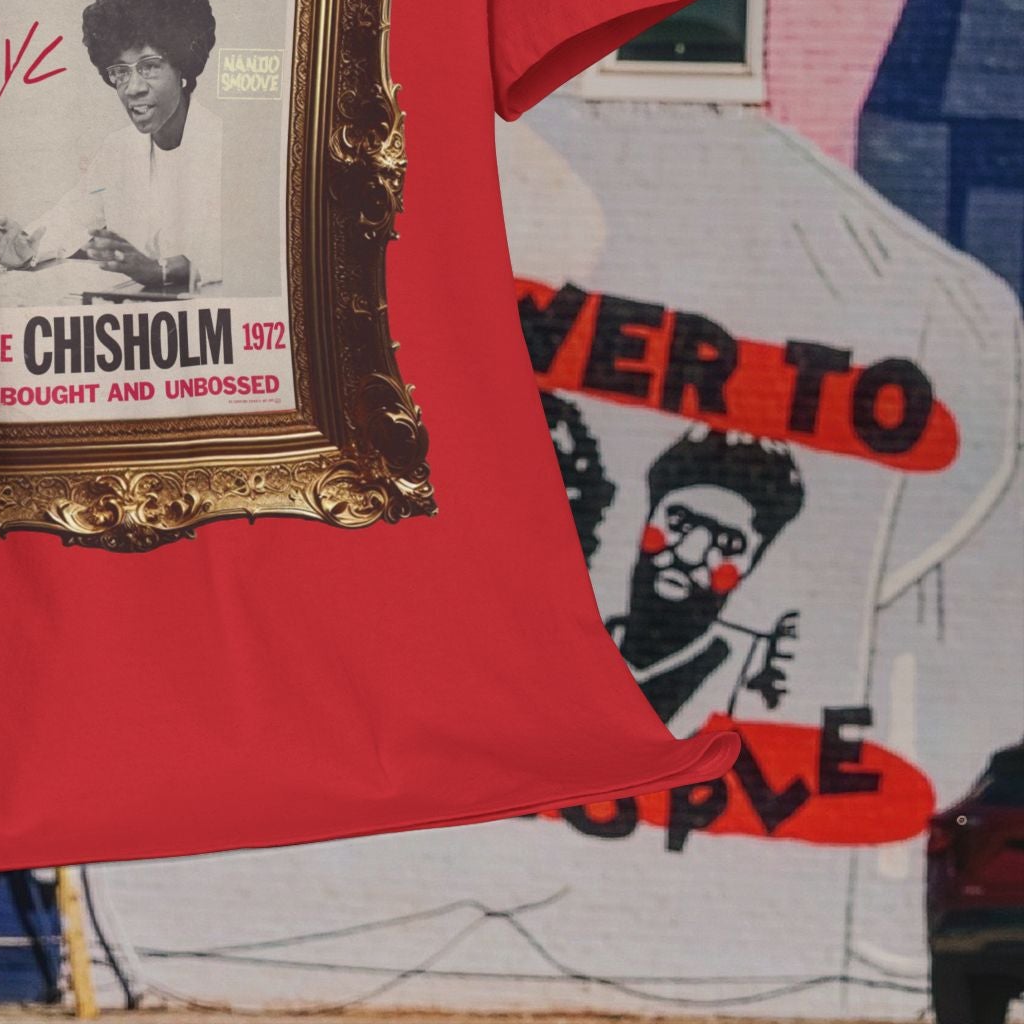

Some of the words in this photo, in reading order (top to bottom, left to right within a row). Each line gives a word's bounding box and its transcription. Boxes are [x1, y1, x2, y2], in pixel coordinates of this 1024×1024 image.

[223, 54, 281, 73] NANDO
[221, 72, 280, 92] SMOOVE
[23, 308, 233, 375] CHISHOLM
[242, 321, 287, 351] 1972
[107, 380, 155, 402] AND
[165, 374, 280, 400] UNBOSSED
[786, 340, 933, 453] TO
